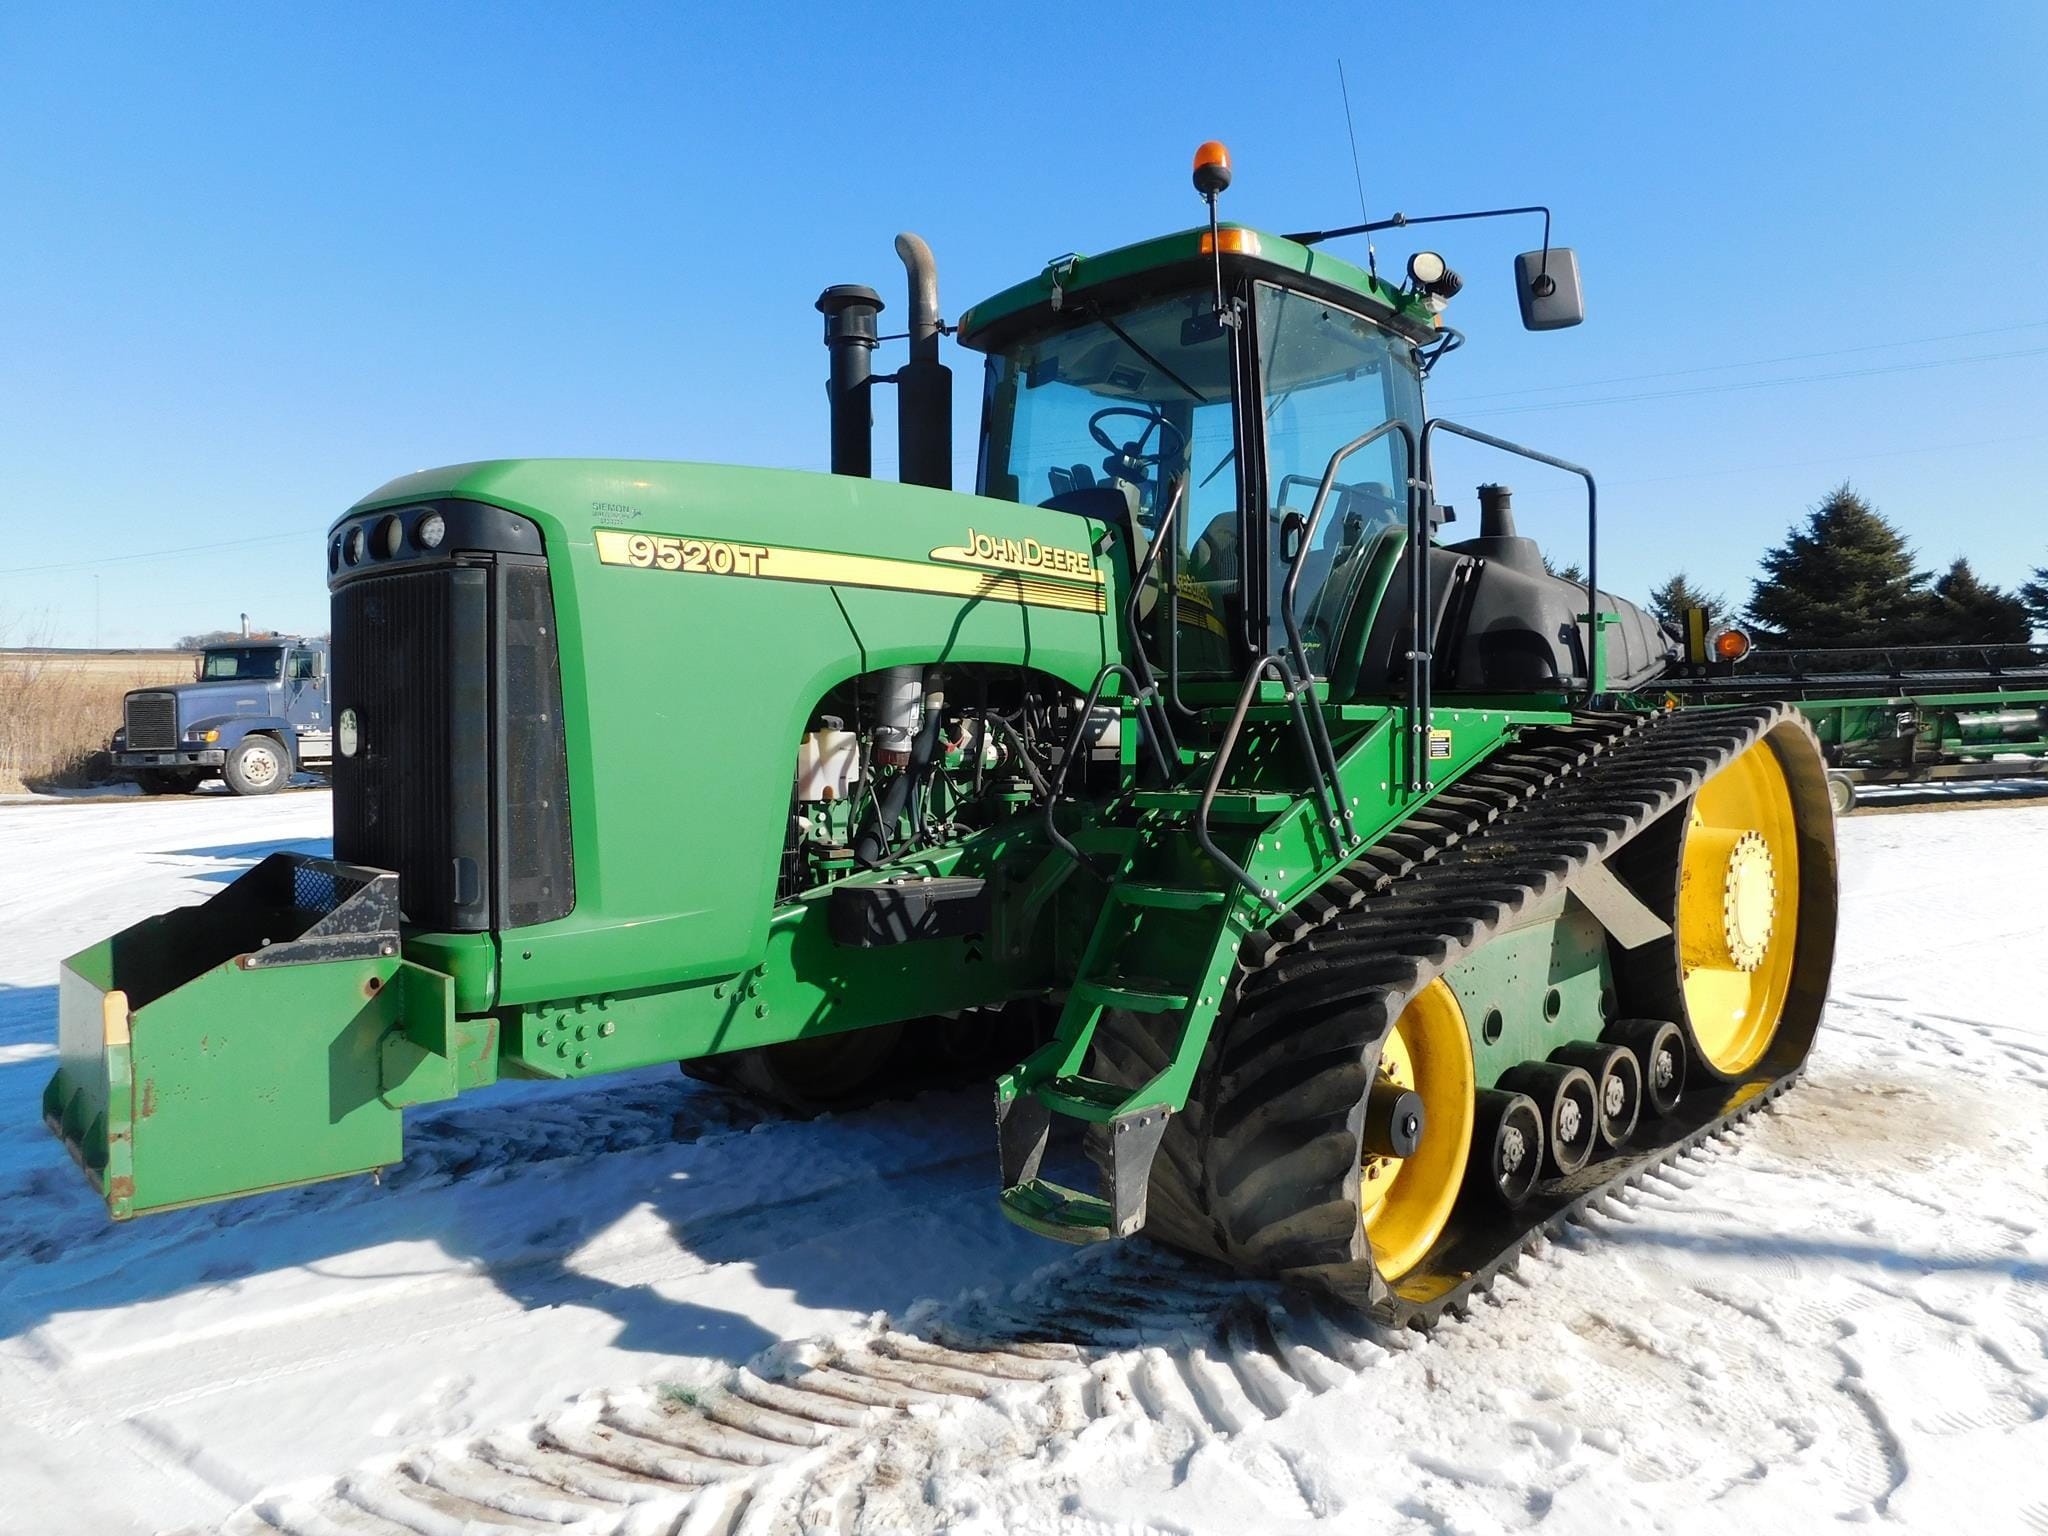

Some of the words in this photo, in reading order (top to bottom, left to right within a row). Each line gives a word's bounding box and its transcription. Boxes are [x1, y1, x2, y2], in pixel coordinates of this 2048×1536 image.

[628, 535, 768, 576] 9520T
[964, 528, 1024, 564] JOHN
[1024, 538, 1091, 575] DEERE
